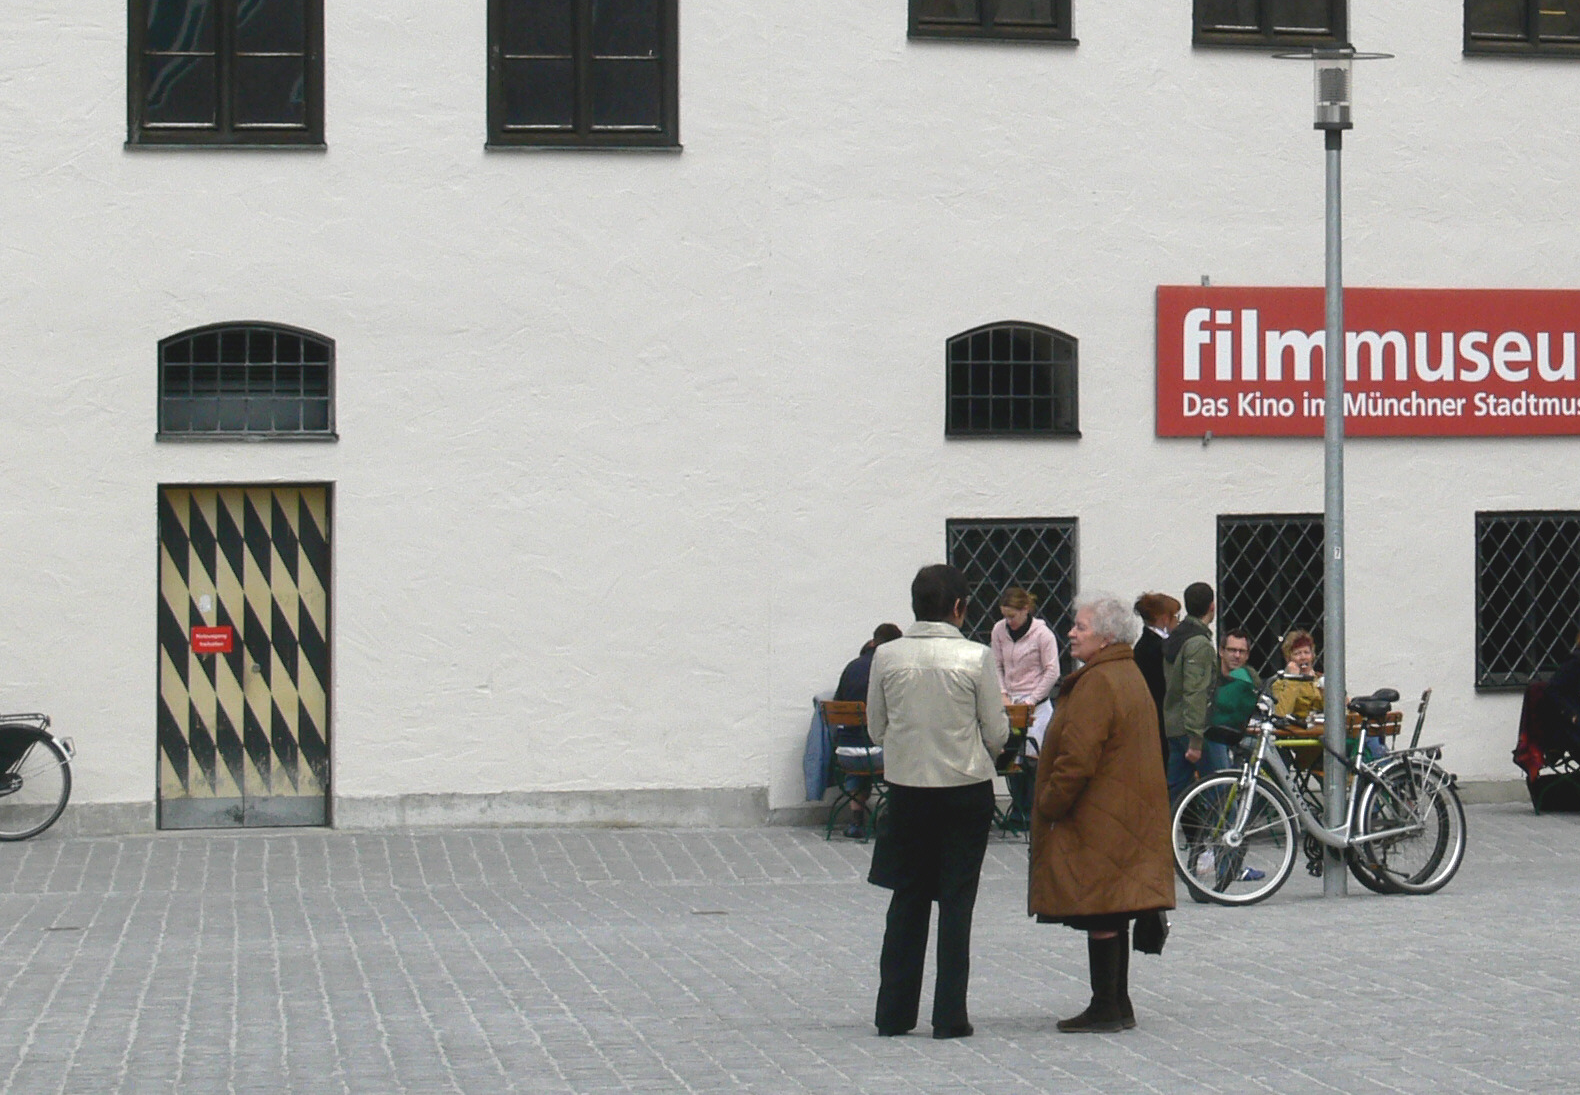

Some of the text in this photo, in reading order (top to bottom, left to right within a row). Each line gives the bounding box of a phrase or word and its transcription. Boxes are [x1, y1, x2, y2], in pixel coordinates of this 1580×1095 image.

[1183, 391, 1229, 417] Das
[1238, 391, 1295, 417] Kino
[1343, 391, 1466, 417] Münchner
